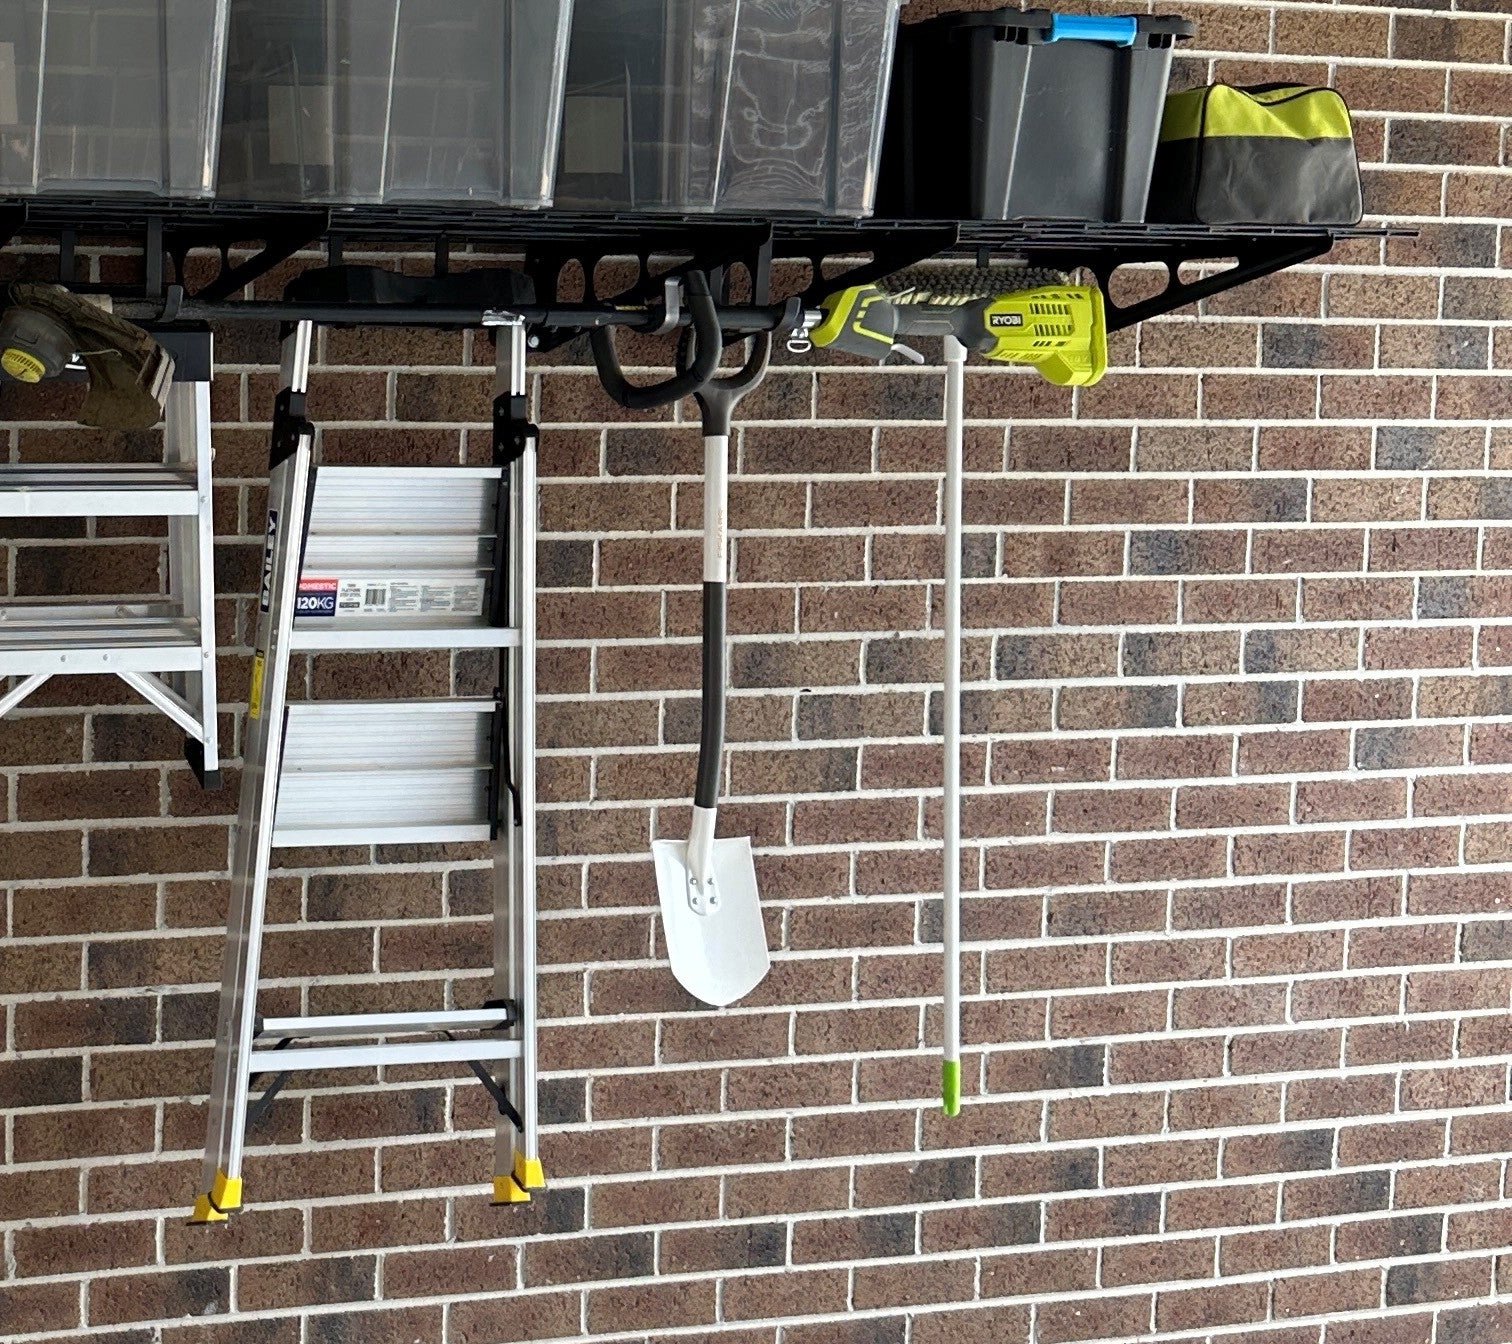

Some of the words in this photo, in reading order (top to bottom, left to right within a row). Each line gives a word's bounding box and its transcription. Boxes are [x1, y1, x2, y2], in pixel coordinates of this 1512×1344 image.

[991, 315, 1022, 325] RYOBI
[262, 516, 276, 606] BAILEY
[297, 596, 334, 610] 120KG
